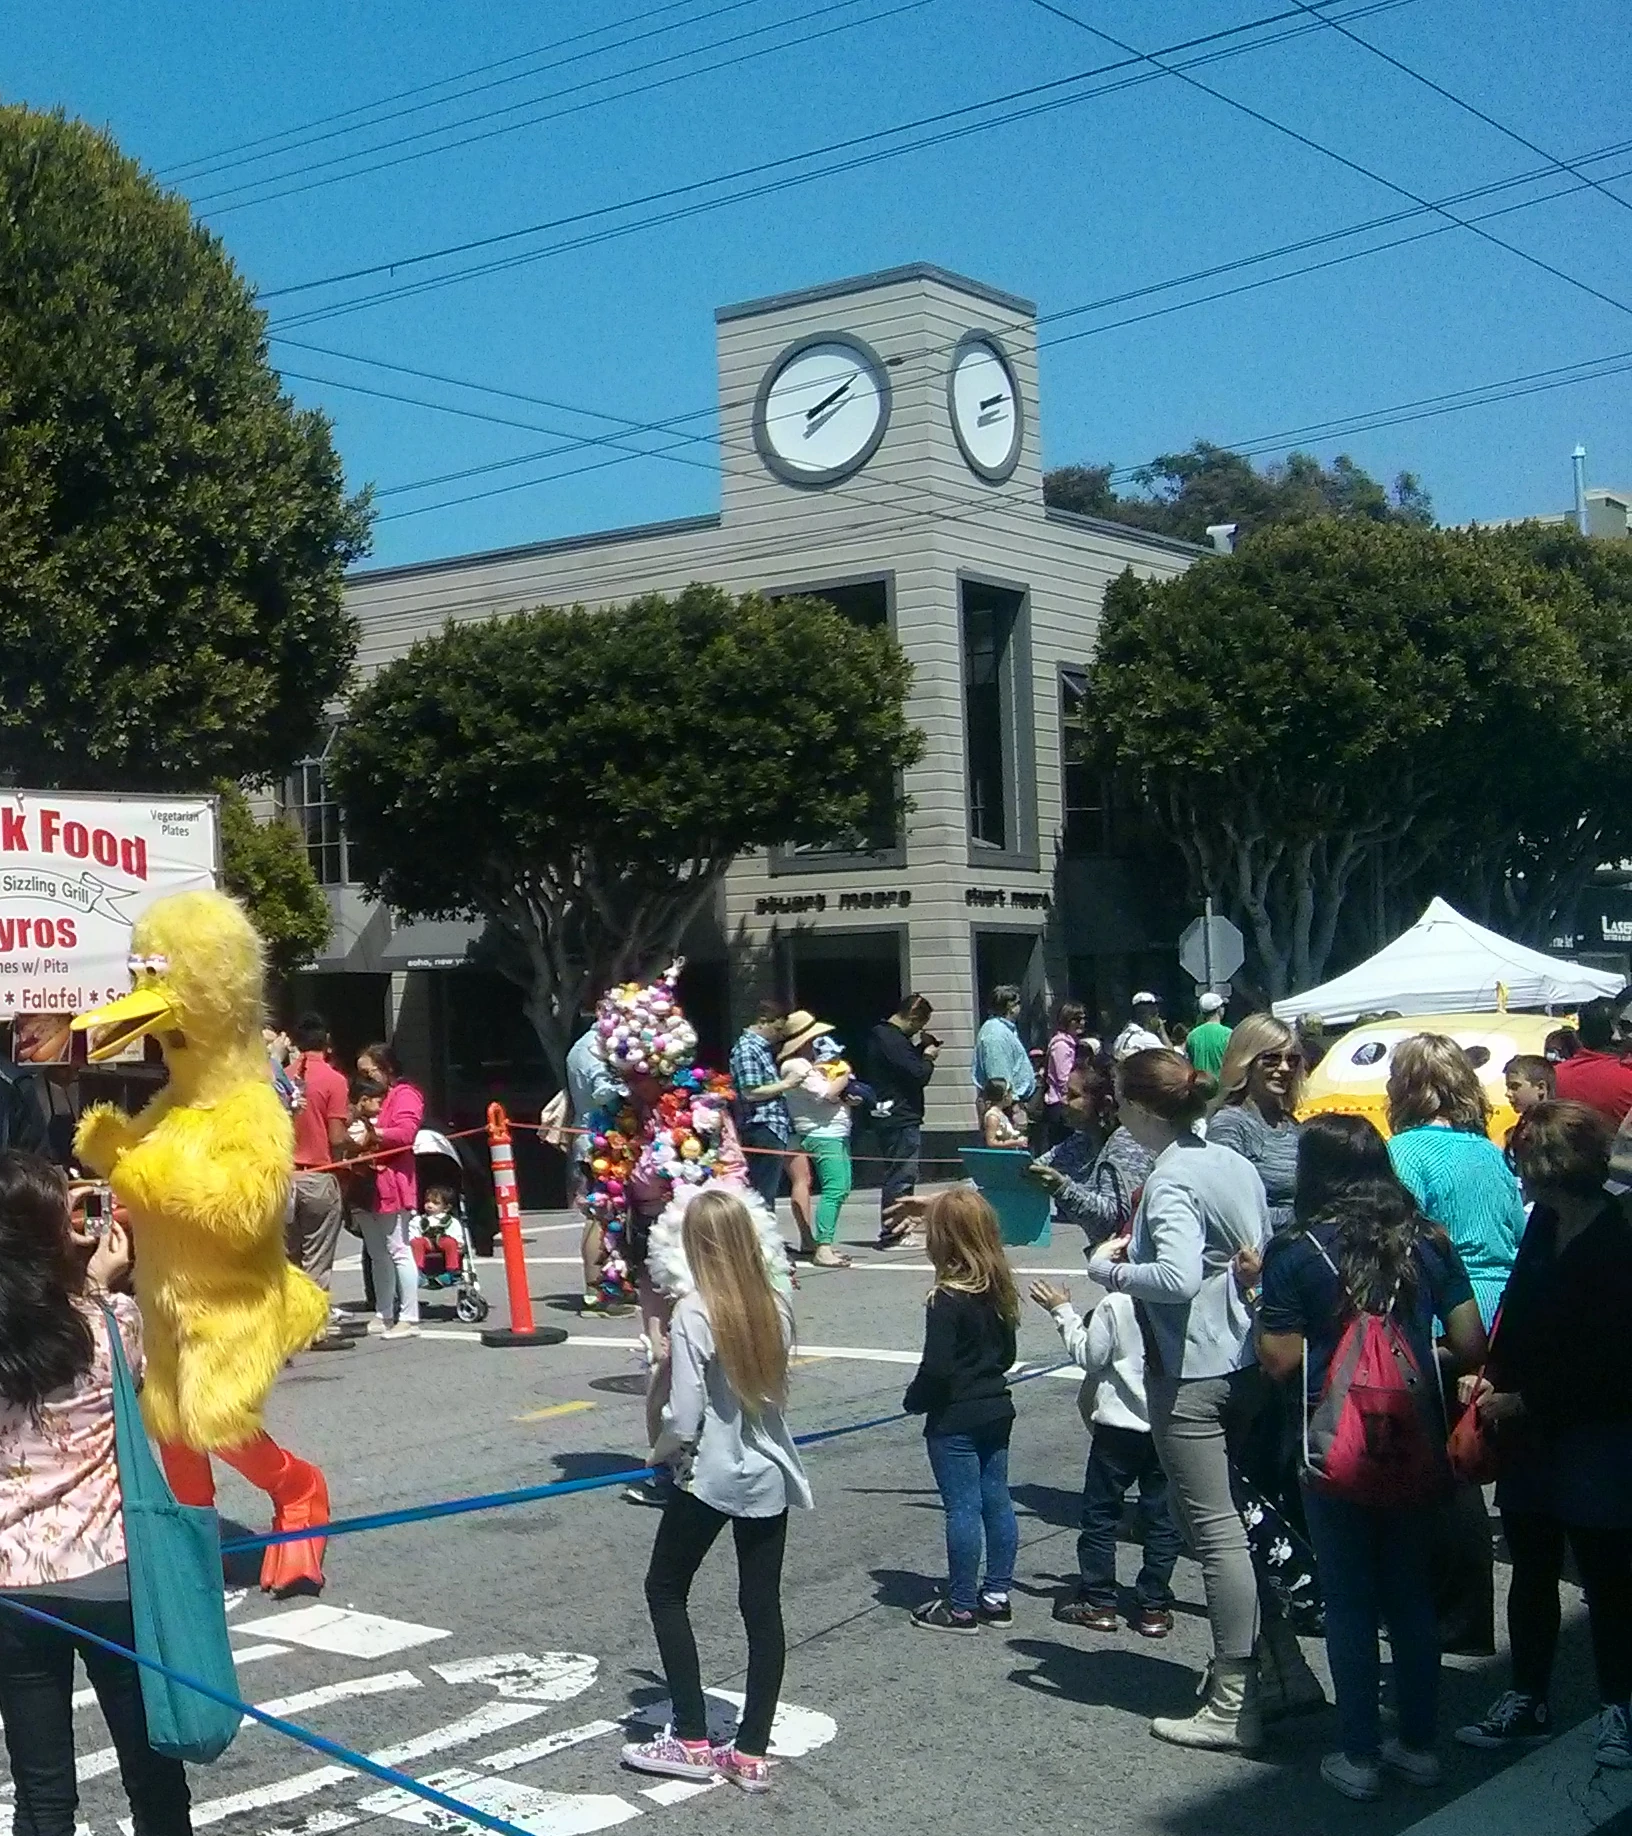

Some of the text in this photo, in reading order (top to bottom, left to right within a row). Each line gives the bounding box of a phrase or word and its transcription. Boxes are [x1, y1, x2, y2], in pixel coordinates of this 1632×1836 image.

[150, 809, 199, 823] Vegetarian
[161, 824, 190, 837] Plates
[39, 809, 148, 881] Food
[1, 875, 57, 898] Sizzling
[61, 880, 90, 906] Grill
[22, 957, 40, 976] w/
[44, 958, 69, 974] Pita
[22, 987, 82, 1009] Falafel
